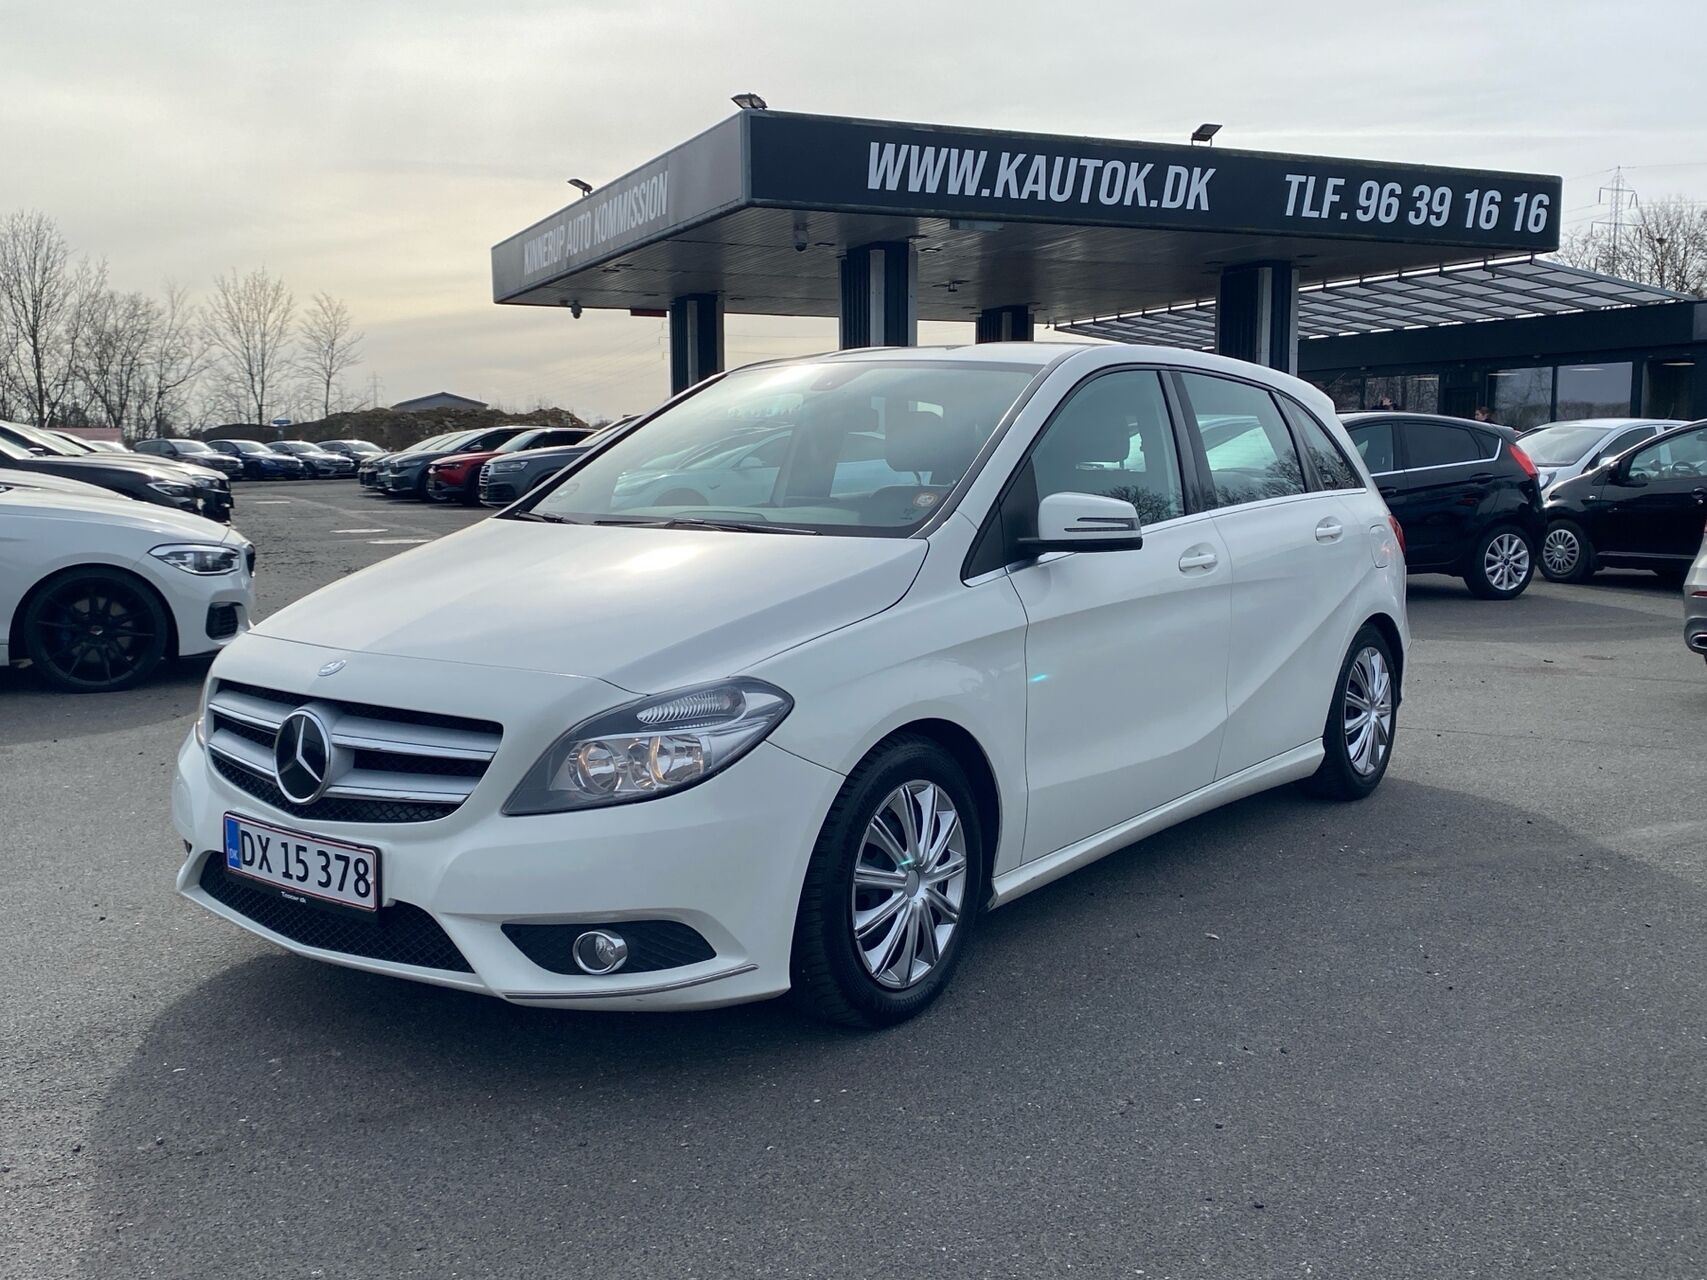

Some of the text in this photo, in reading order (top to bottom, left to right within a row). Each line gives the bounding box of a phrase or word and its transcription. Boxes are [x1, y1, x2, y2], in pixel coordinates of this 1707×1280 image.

[867, 141, 1216, 211] WWW.KAUTOK.DK
[1285, 174, 1550, 233] TLF. 96 39 16 16
[524, 170, 668, 276] KINNERUP AUTO KOMMISSION
[240, 830, 371, 898] DX 15 378
